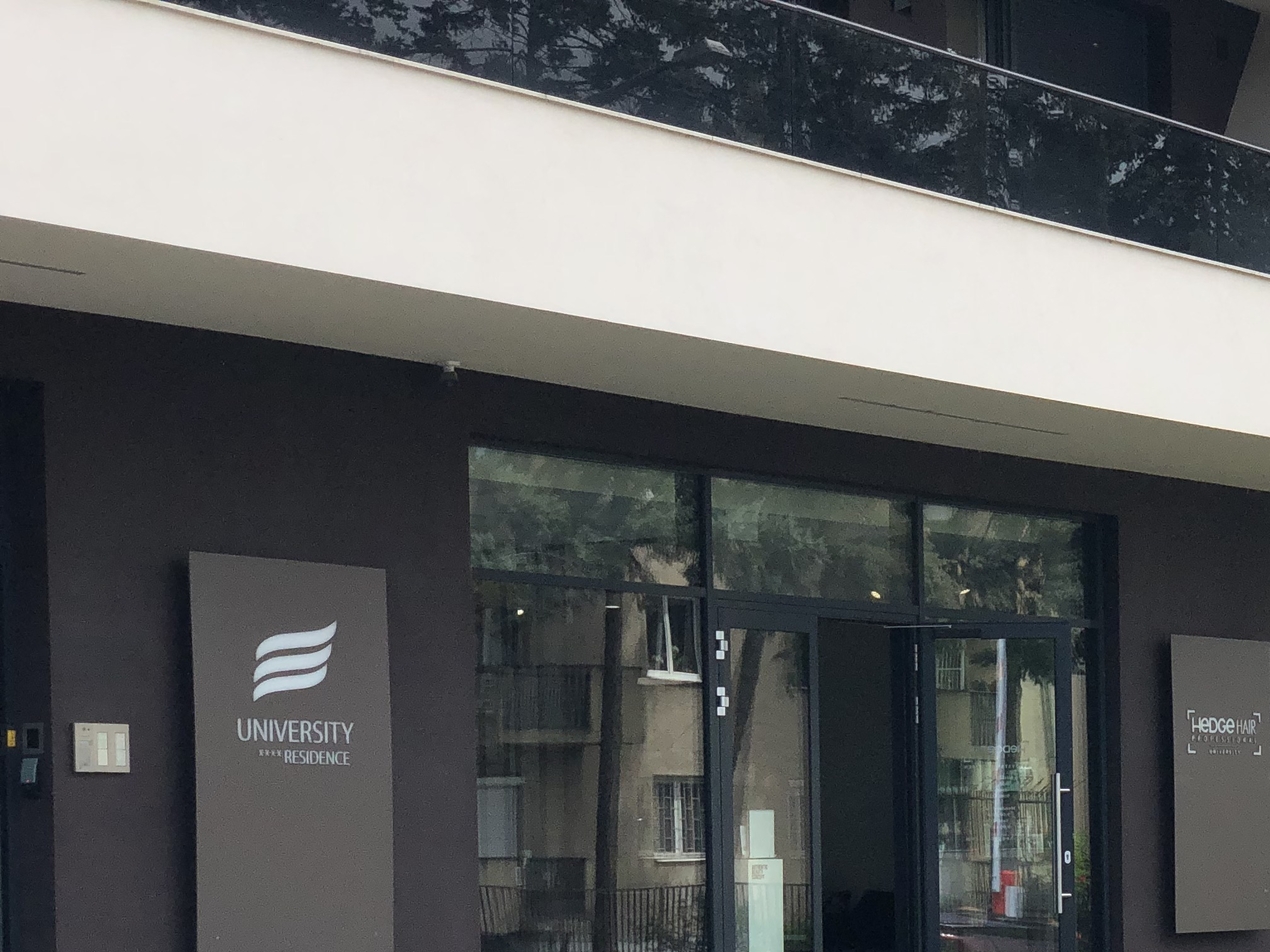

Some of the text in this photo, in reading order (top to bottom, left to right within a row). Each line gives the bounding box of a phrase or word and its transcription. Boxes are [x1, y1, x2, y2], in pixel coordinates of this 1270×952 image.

[237, 718, 355, 744] UNIVERSITY
[1236, 719, 1257, 735] HAIR
[284, 749, 351, 766] RESIDENCE
